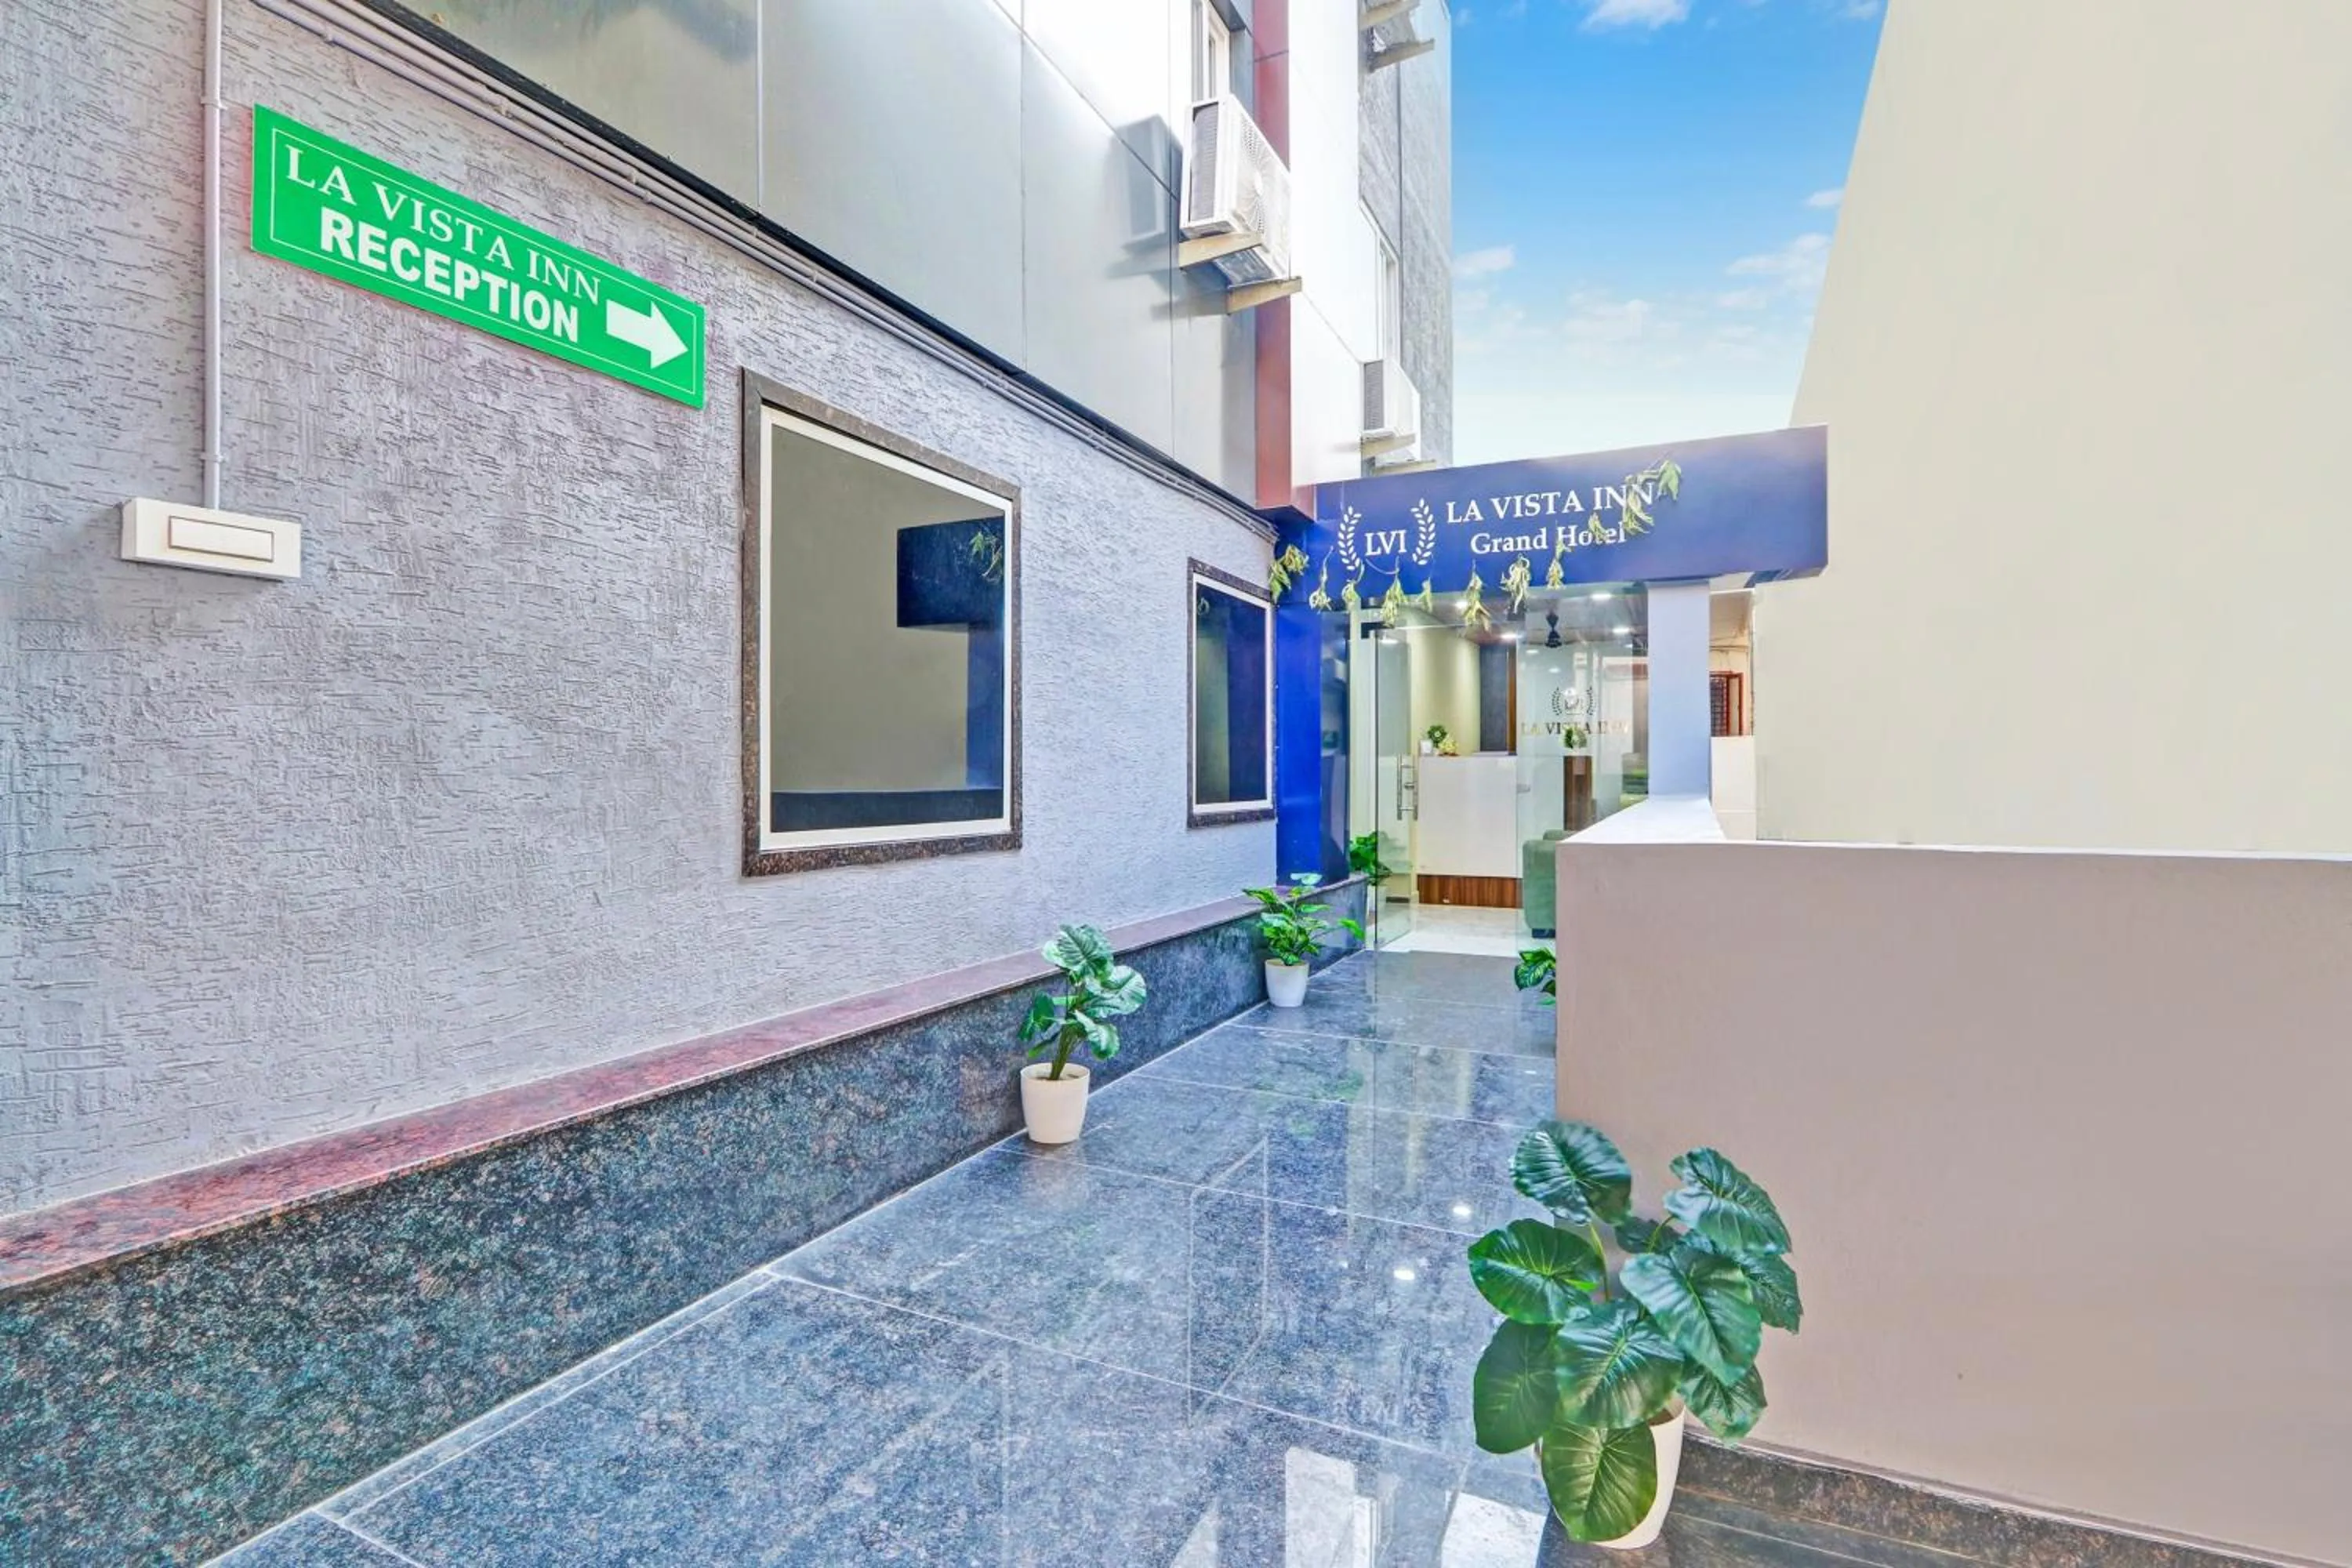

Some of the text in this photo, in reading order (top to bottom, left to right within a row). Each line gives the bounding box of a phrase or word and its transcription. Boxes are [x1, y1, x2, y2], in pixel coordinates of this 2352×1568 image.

[285, 144, 601, 305] LA VISTA INN
[320, 206, 579, 343] RECEPTION
[1446, 500, 1484, 524] LA
[1490, 492, 1585, 520] VISTA
[1364, 529, 1407, 556] LVI
[1470, 528, 1548, 554] Grand
